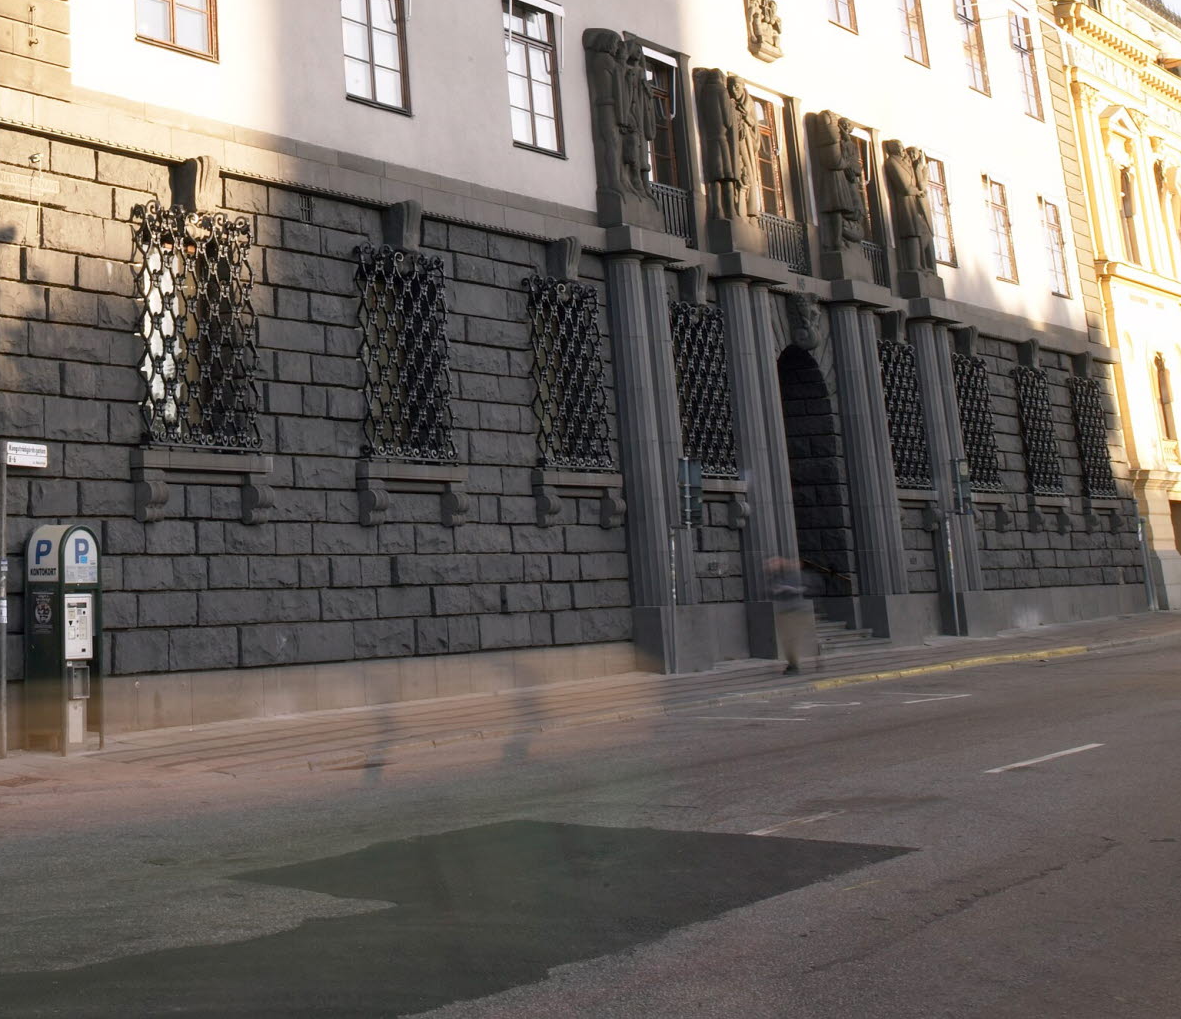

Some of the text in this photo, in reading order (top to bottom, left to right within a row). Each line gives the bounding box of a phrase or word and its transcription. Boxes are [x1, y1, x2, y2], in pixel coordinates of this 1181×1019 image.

[35, 539, 52, 565] P
[74, 538, 90, 564] P
[30, 568, 56, 576] KONTOKORT
